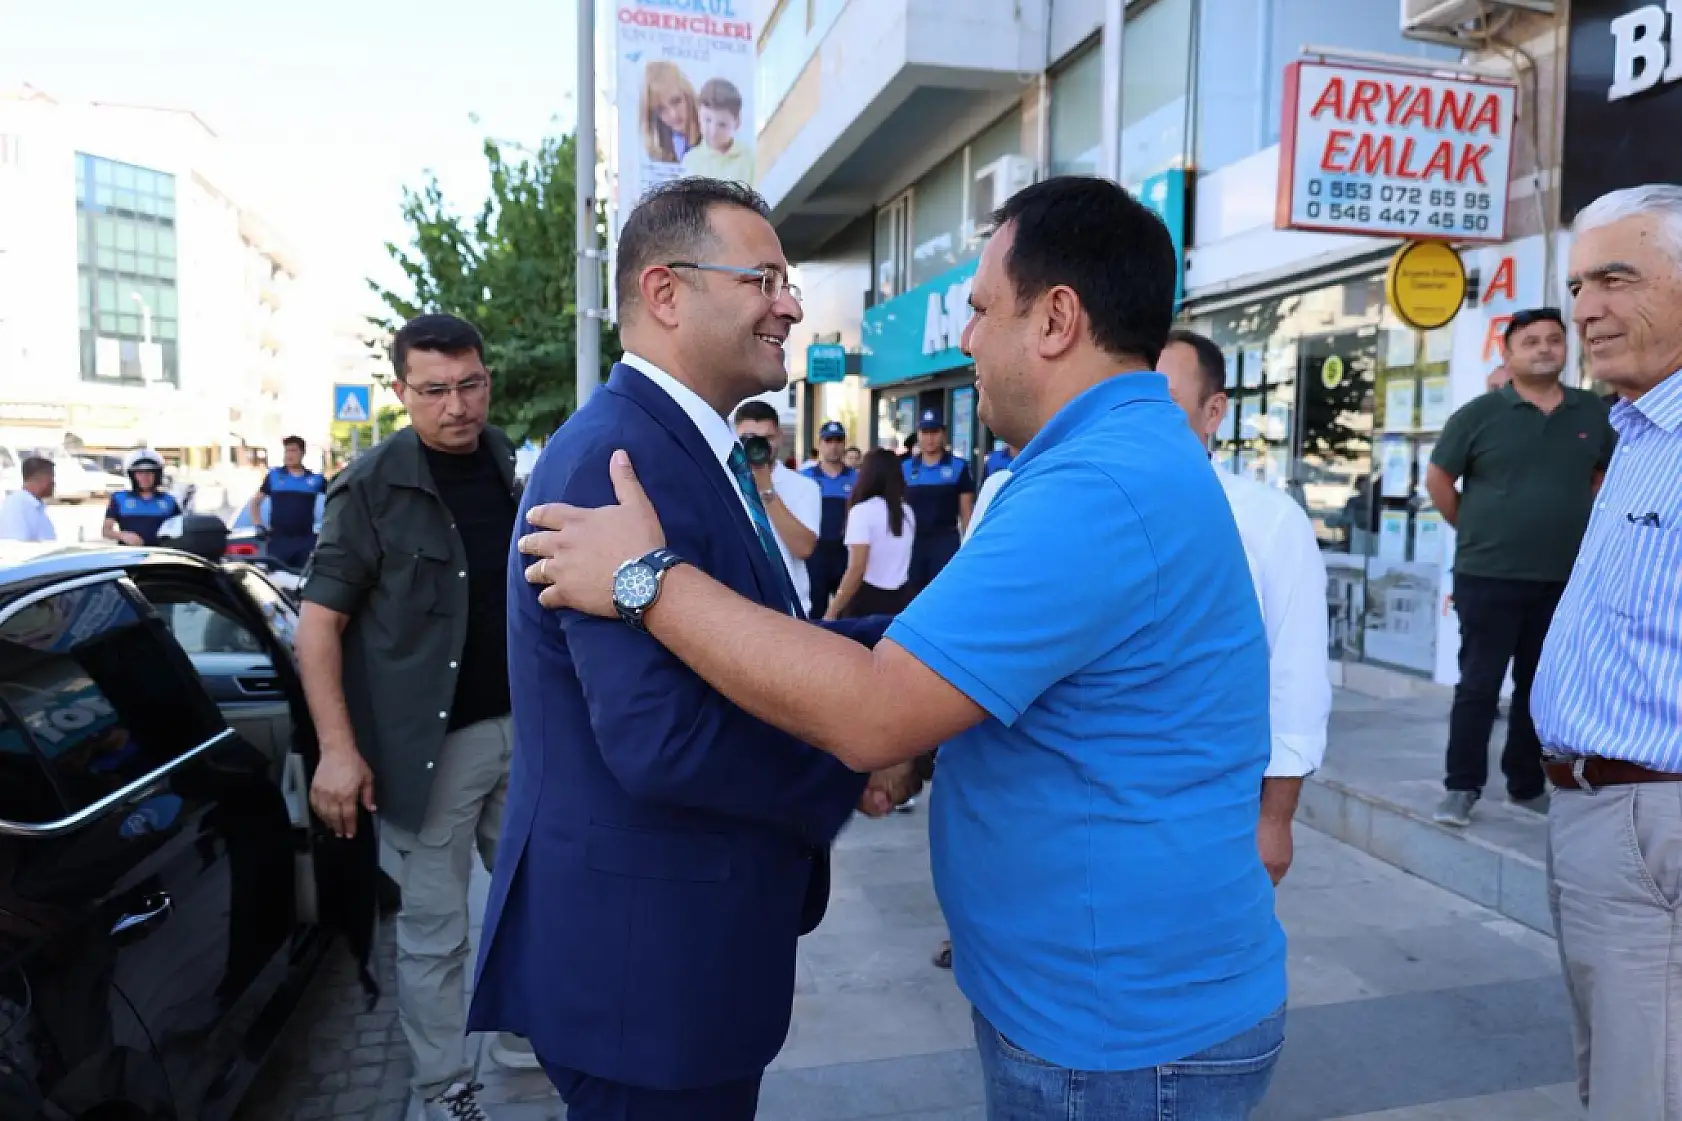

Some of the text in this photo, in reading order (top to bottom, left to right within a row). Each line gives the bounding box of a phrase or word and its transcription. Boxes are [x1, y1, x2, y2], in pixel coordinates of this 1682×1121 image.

[1309, 76, 1501, 135] ARYANA
[1320, 129, 1491, 183] EMLAK
[1307, 201, 1320, 218] 0
[1329, 203, 1370, 222] 546
[1378, 207, 1420, 226] 447
[1428, 211, 1455, 229] 45
[1308, 179, 1491, 210] 0 553 072 65 95
